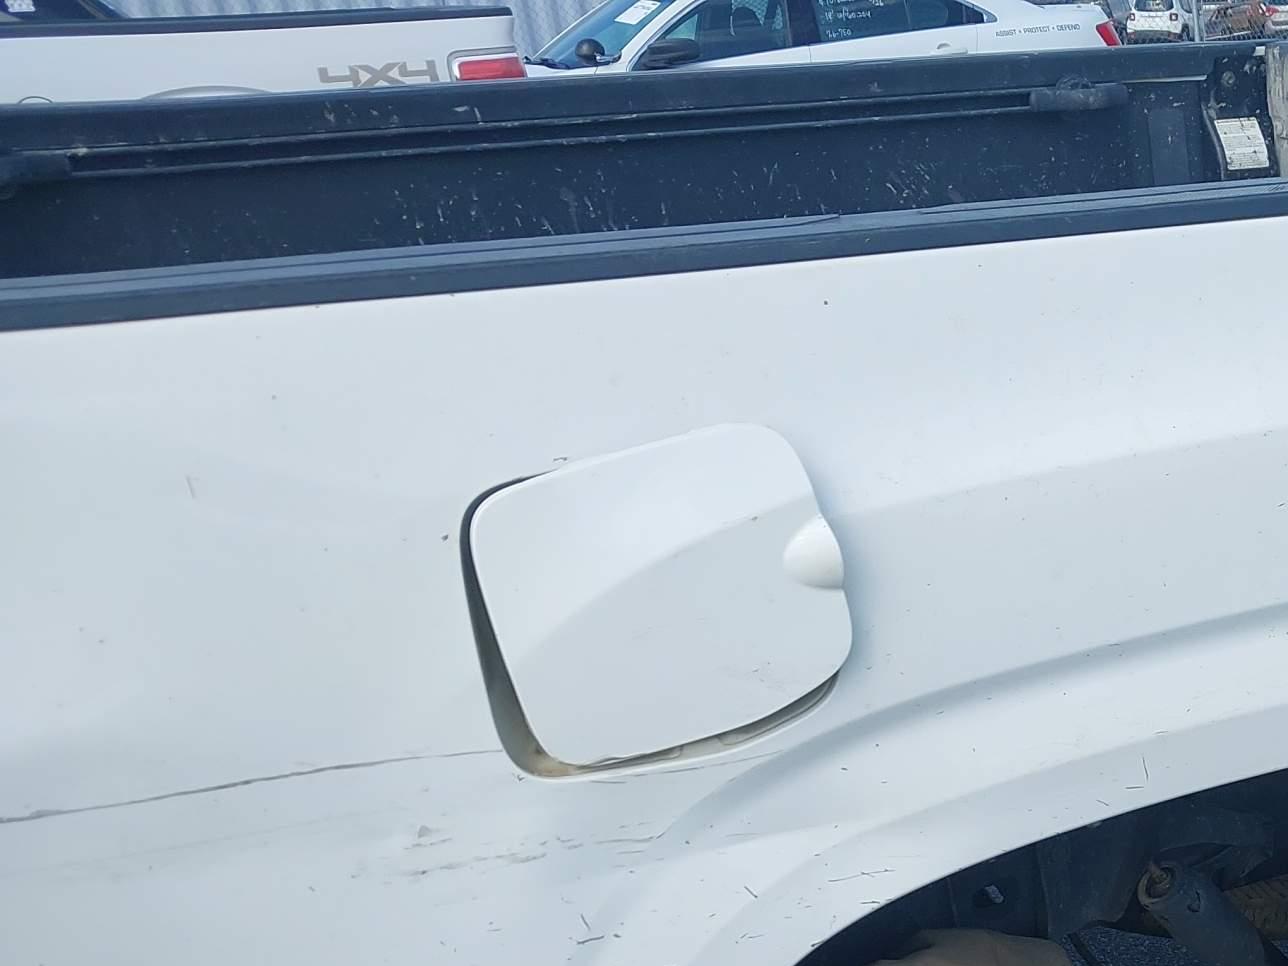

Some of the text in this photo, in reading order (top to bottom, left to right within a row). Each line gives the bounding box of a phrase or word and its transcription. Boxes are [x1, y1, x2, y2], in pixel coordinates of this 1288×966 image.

[995, 23, 1081, 37] ASSIST PROTECT DEFEND
